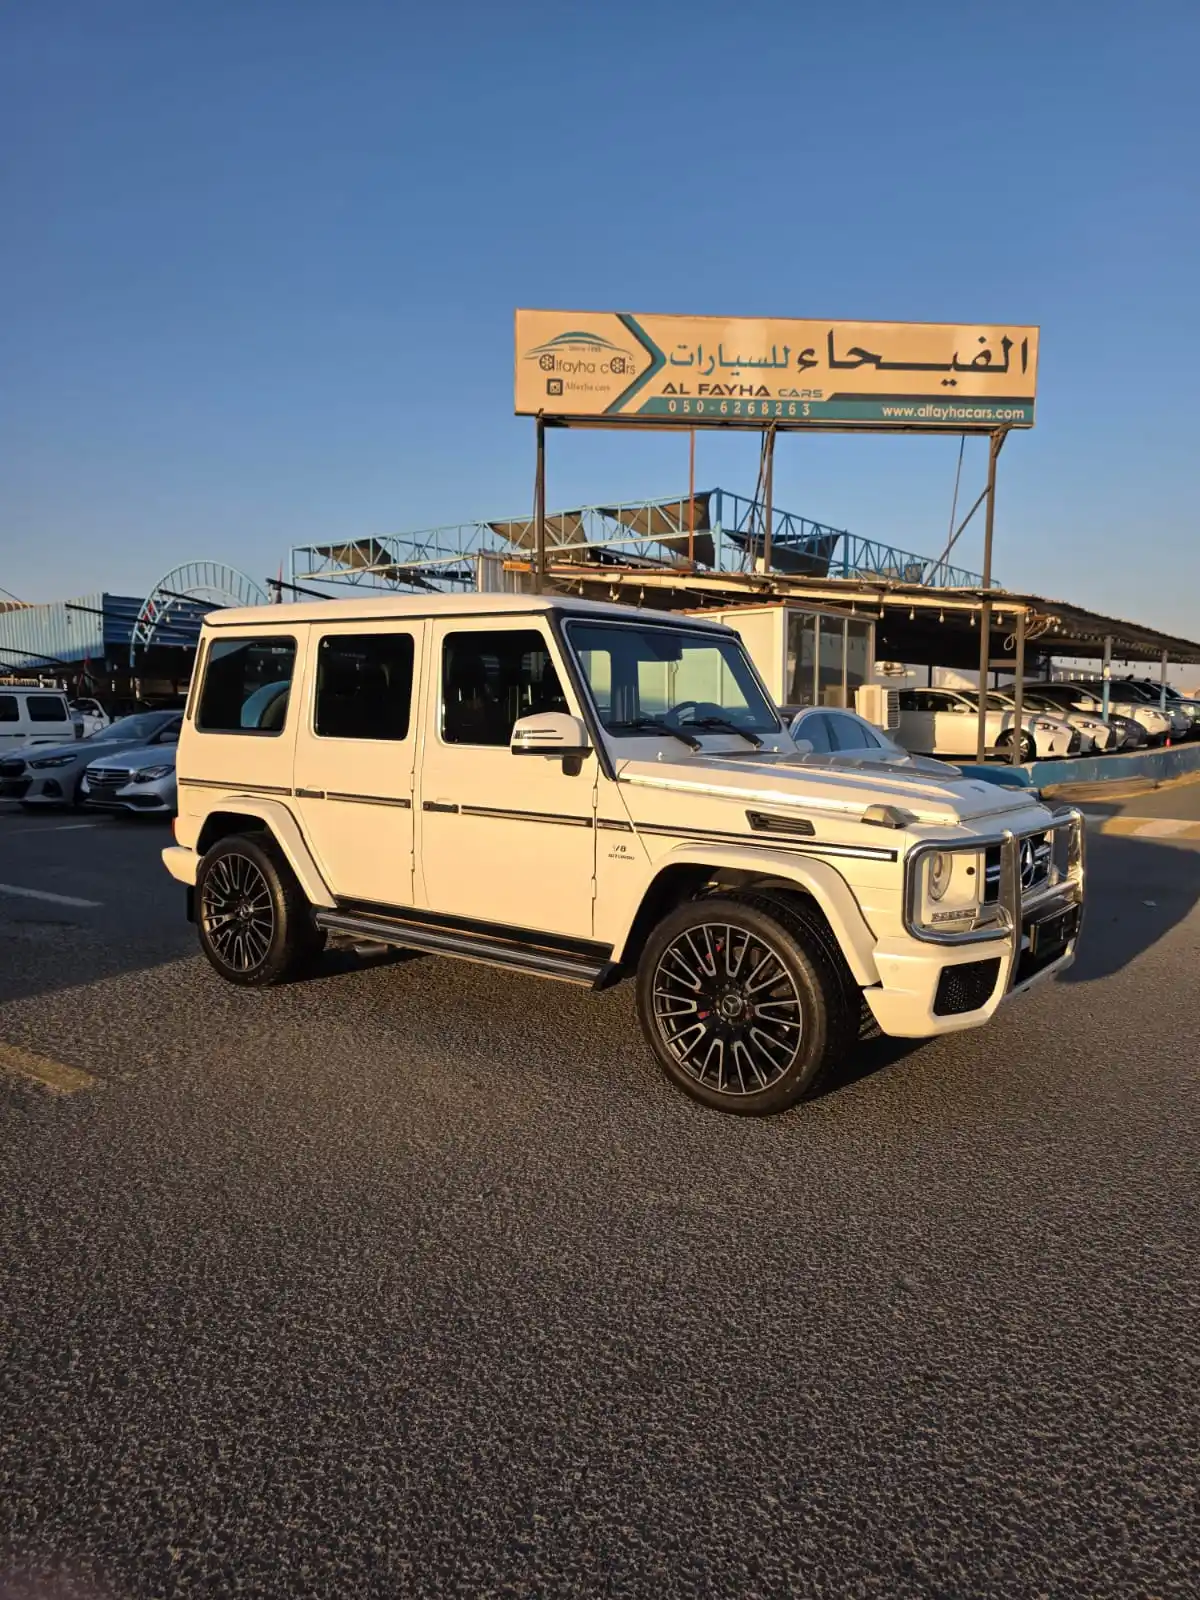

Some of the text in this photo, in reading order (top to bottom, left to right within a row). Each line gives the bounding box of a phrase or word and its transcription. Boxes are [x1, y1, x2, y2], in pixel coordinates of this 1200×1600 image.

[669, 328, 1029, 387] الفيحاء للسيارات
[661, 382, 823, 398] AL FAYHA CARS
[882, 405, 1025, 420] www.alfayhacars.com
